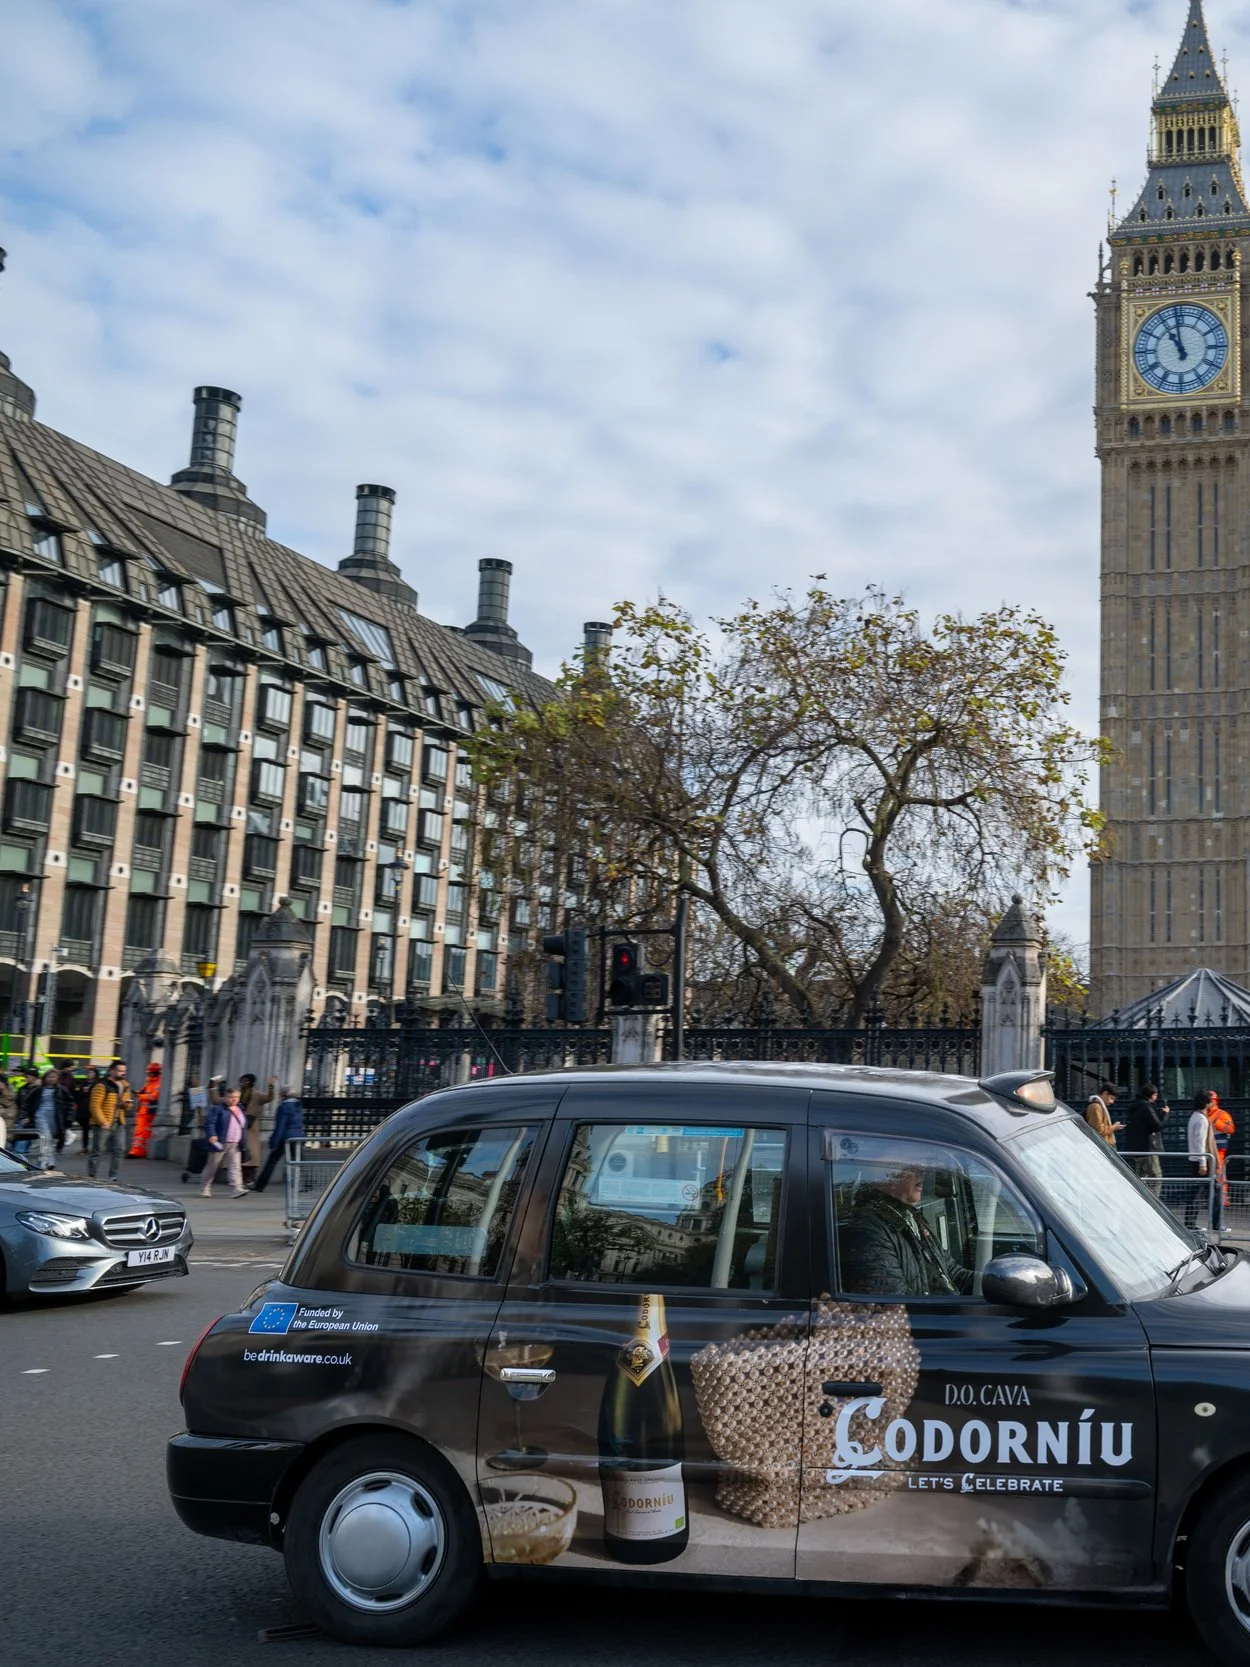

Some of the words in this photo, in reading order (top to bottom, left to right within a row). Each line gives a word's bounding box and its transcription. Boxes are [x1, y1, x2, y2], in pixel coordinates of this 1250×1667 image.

[138, 1251, 152, 1263] Y14
[153, 1248, 170, 1261] RJN
[298, 1307, 332, 1318] Funded
[332, 1308, 344, 1320] by
[292, 1320, 307, 1329] the
[308, 1320, 351, 1331] European
[352, 1321, 379, 1331] Union
[243, 1349, 353, 1365] bedrinkaware.co.uk
[945, 1383, 978, 1406] D.O.
[980, 1384, 1031, 1406] CAVA
[825, 1396, 1133, 1485] CODORNÍU
[908, 1477, 954, 1490] LET'S
[960, 1472, 1064, 1493] CELEBRATE
